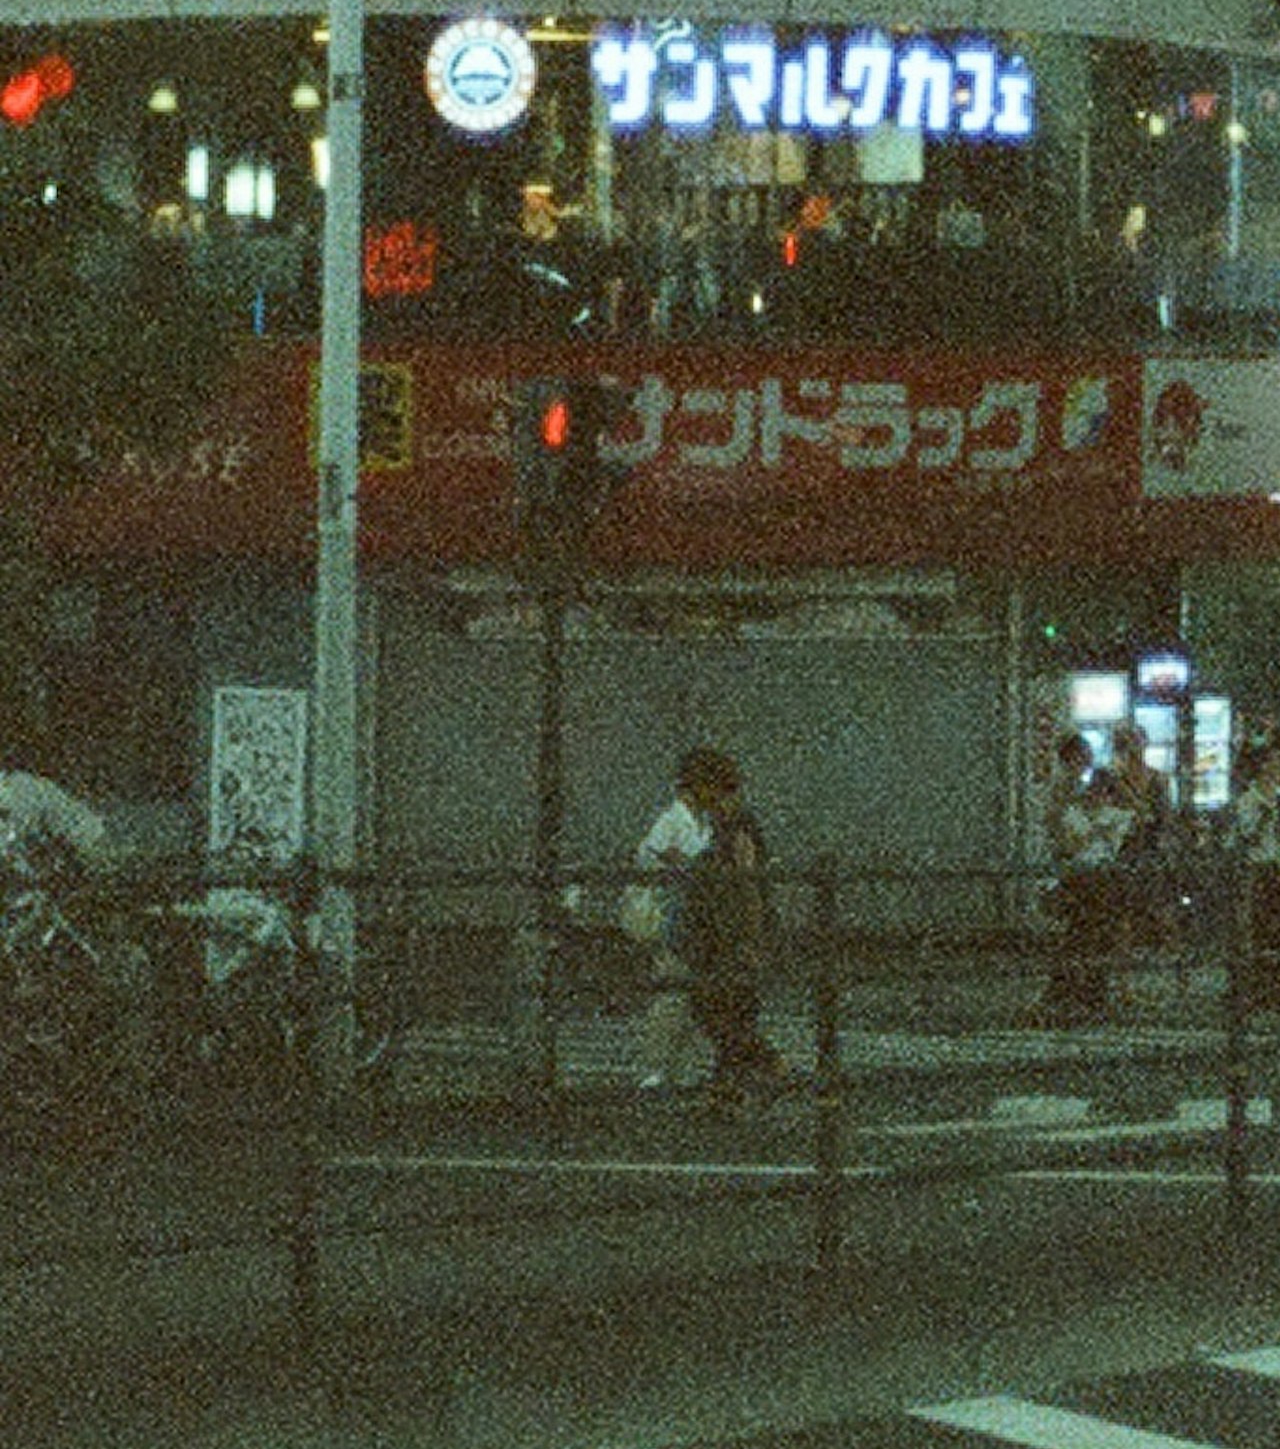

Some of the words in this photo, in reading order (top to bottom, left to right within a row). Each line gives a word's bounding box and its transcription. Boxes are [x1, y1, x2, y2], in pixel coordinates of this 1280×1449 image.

[591, 38, 1033, 134] サンマルクカフェ
